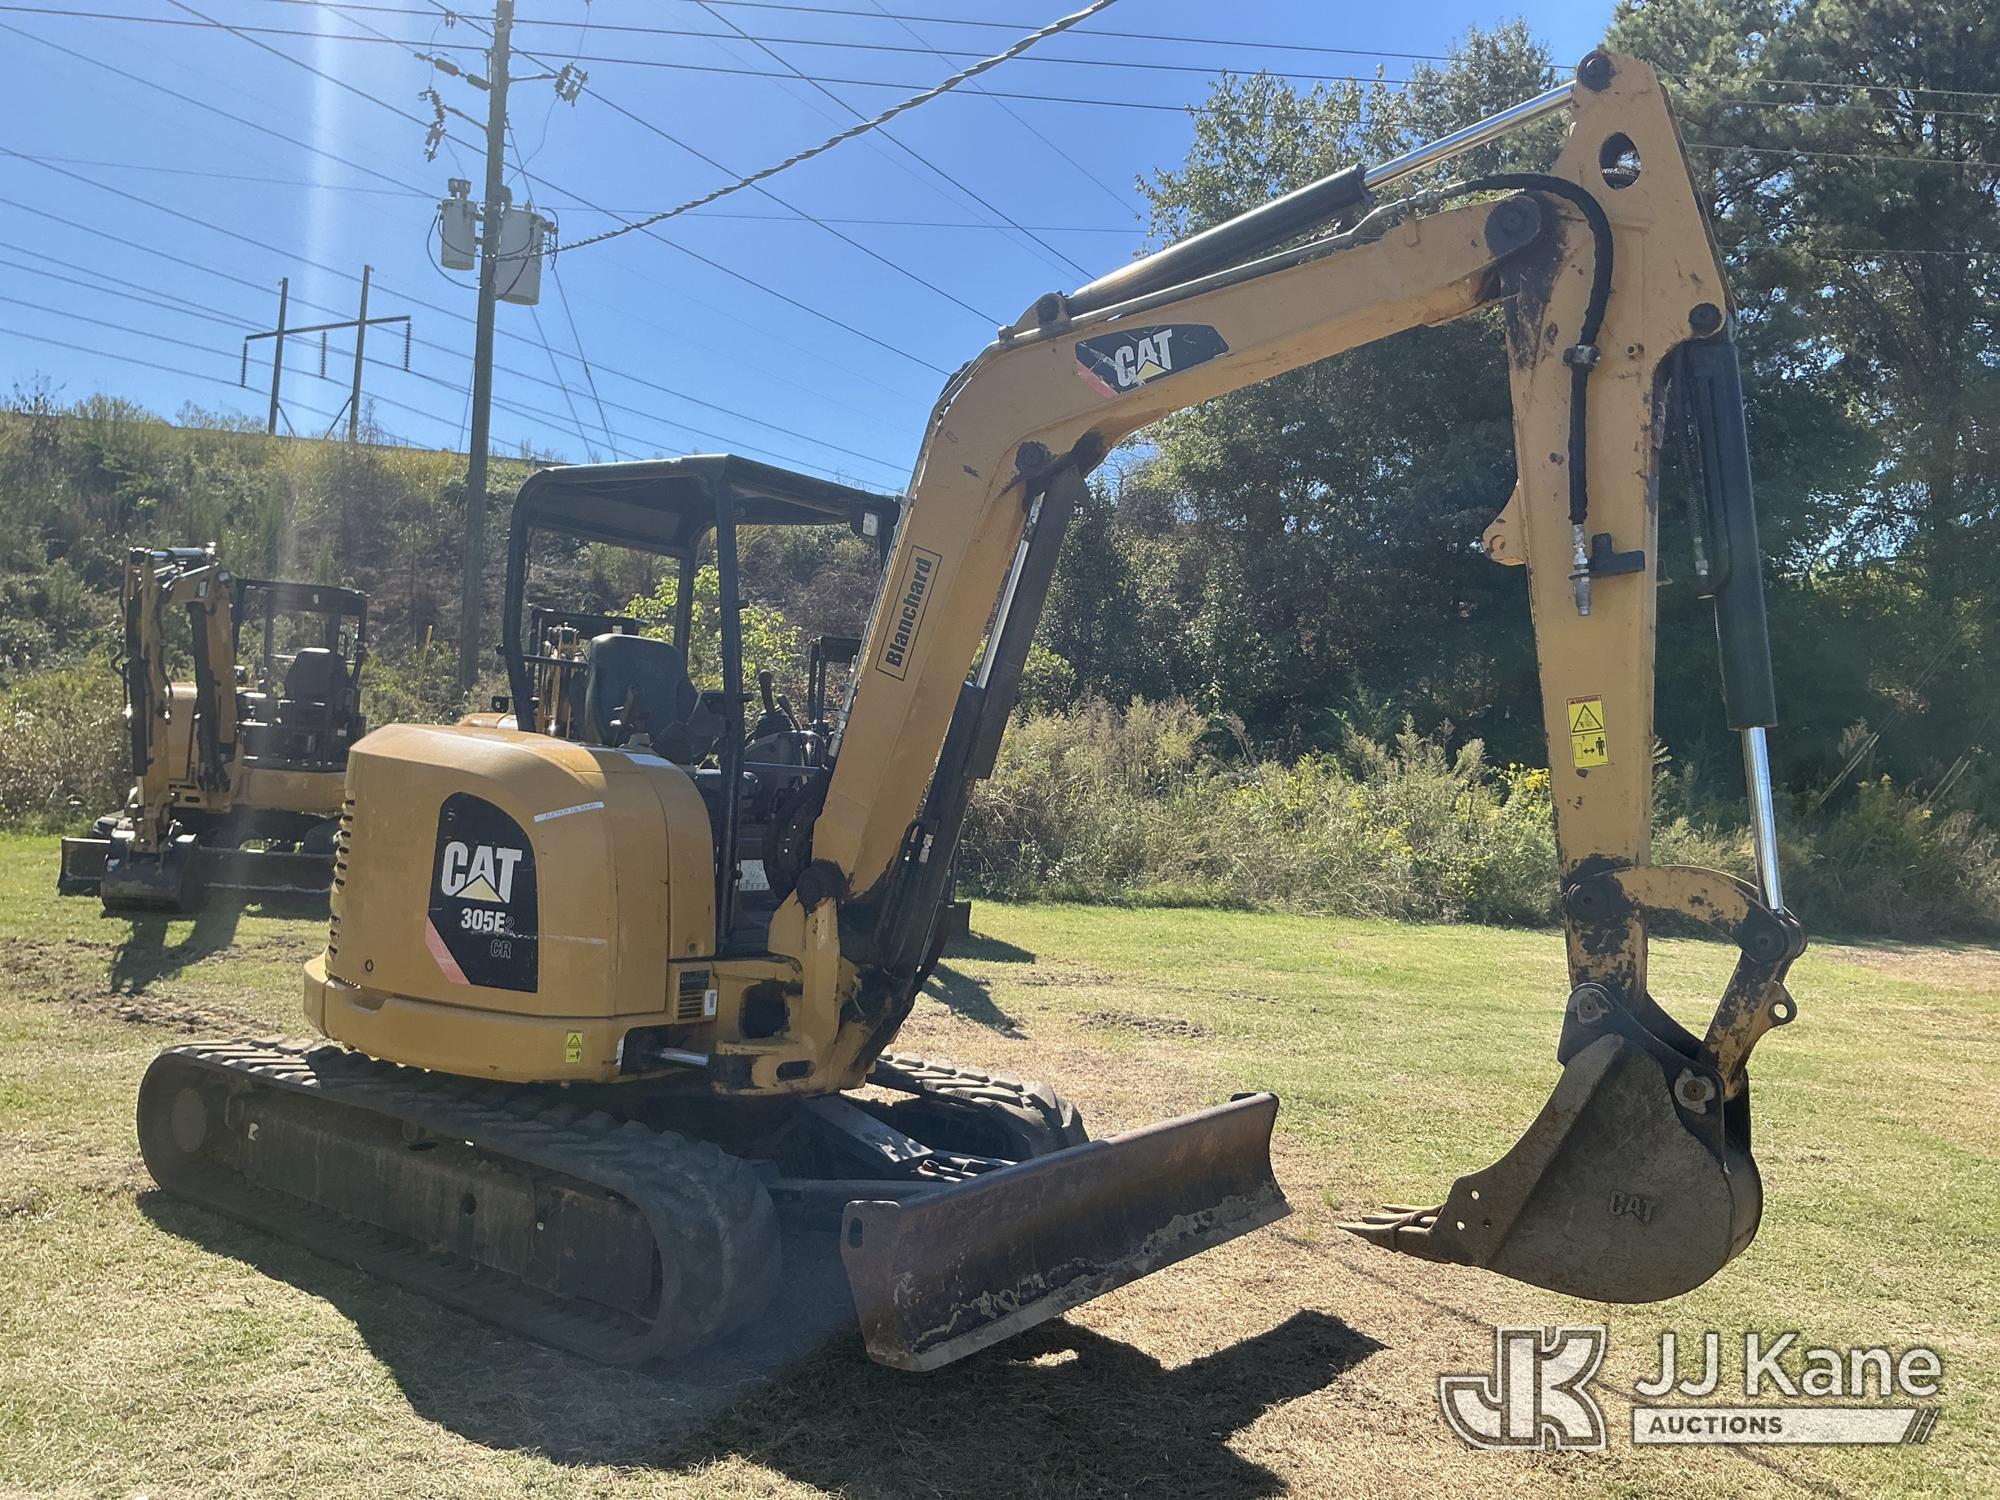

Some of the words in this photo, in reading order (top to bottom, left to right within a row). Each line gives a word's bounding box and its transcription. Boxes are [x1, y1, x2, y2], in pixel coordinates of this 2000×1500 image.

[1115, 329, 1173, 387] CAT
[885, 556, 933, 668] Blanchard
[441, 841, 523, 904] CAT
[490, 939, 512, 959] CR
[1608, 1190, 1660, 1225] CAT
